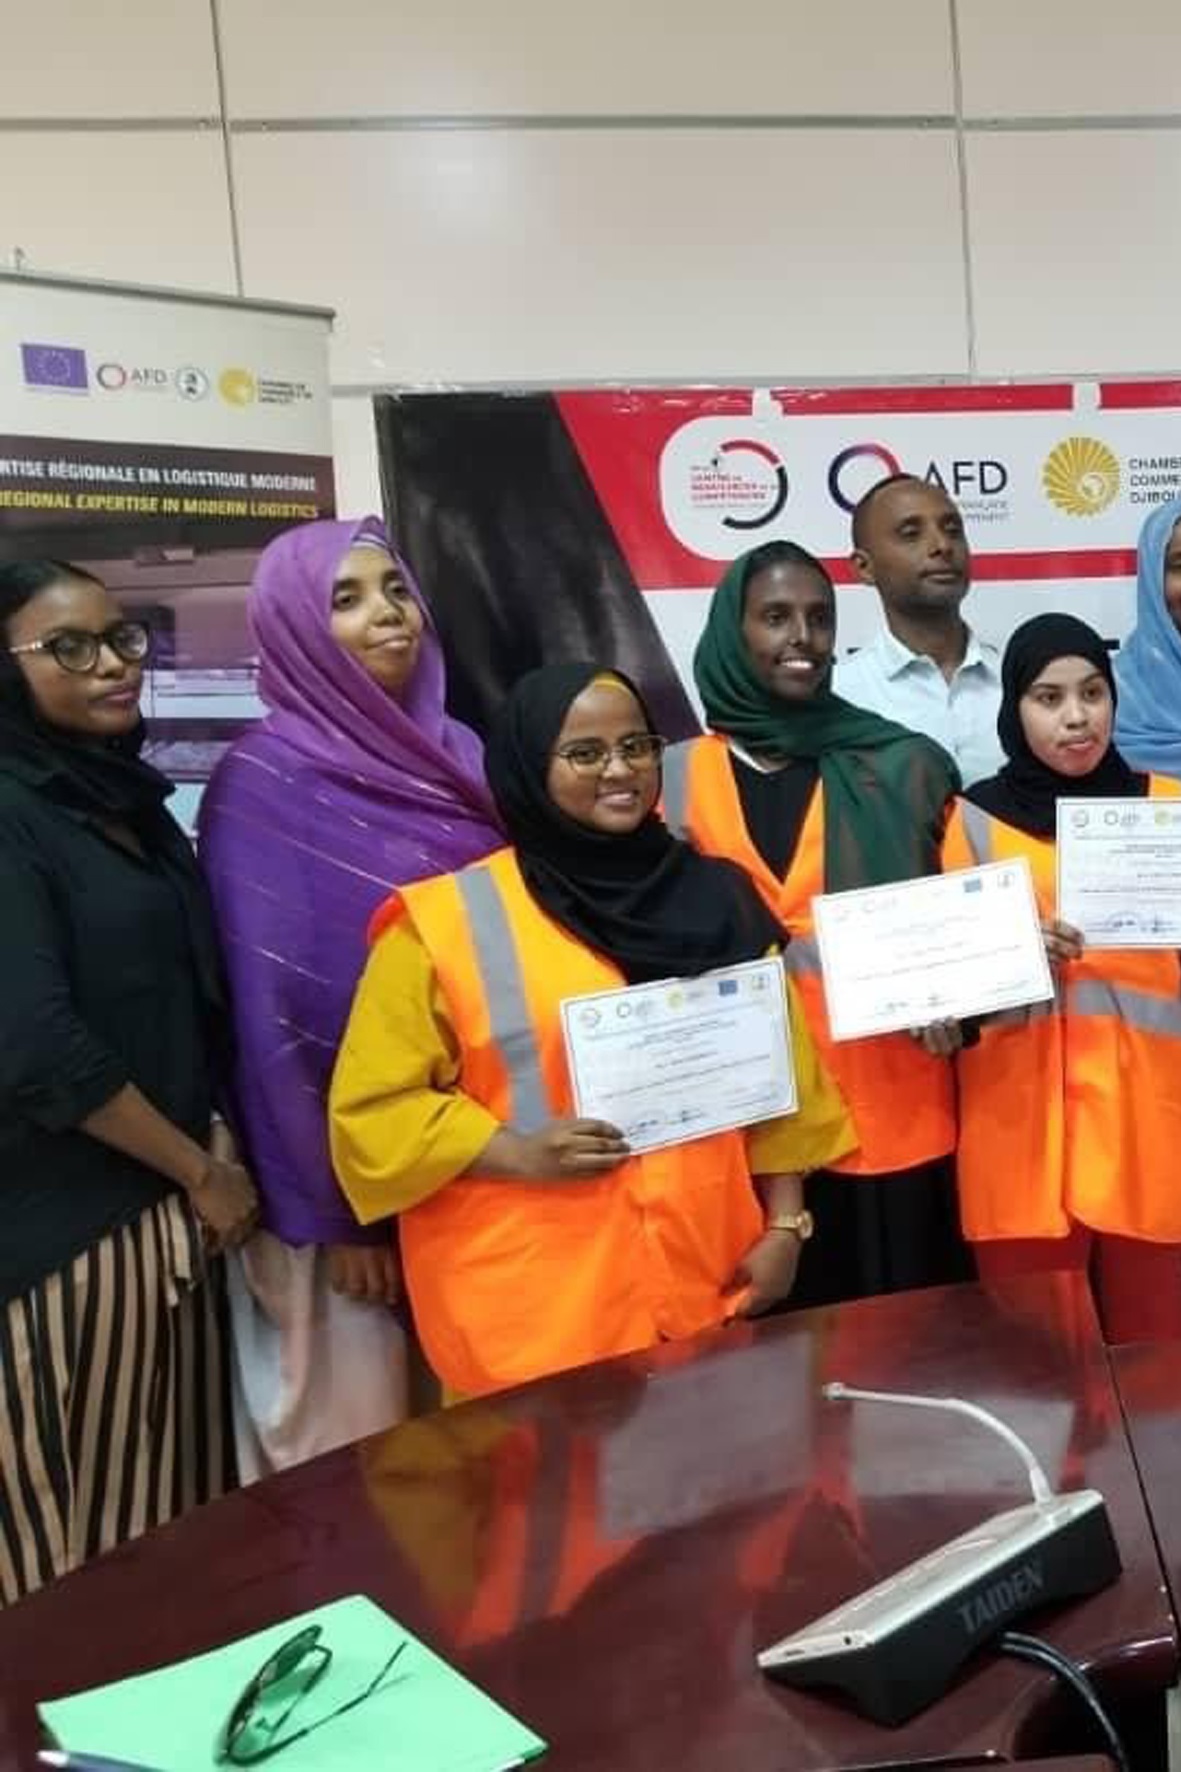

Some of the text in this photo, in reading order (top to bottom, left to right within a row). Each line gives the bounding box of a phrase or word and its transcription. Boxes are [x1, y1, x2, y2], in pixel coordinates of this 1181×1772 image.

[131, 367, 168, 385] AFD
[48, 457, 136, 482] RÉGIONALE
[139, 467, 160, 484] EN
[162, 468, 247, 488] LOGISTIQUE
[924, 460, 1007, 496] AFD
[0, 490, 317, 519] EGIONAL EXPERTISE IN MODERN LOGISTICS
[956, 1565, 1043, 1634] TAIDEN
